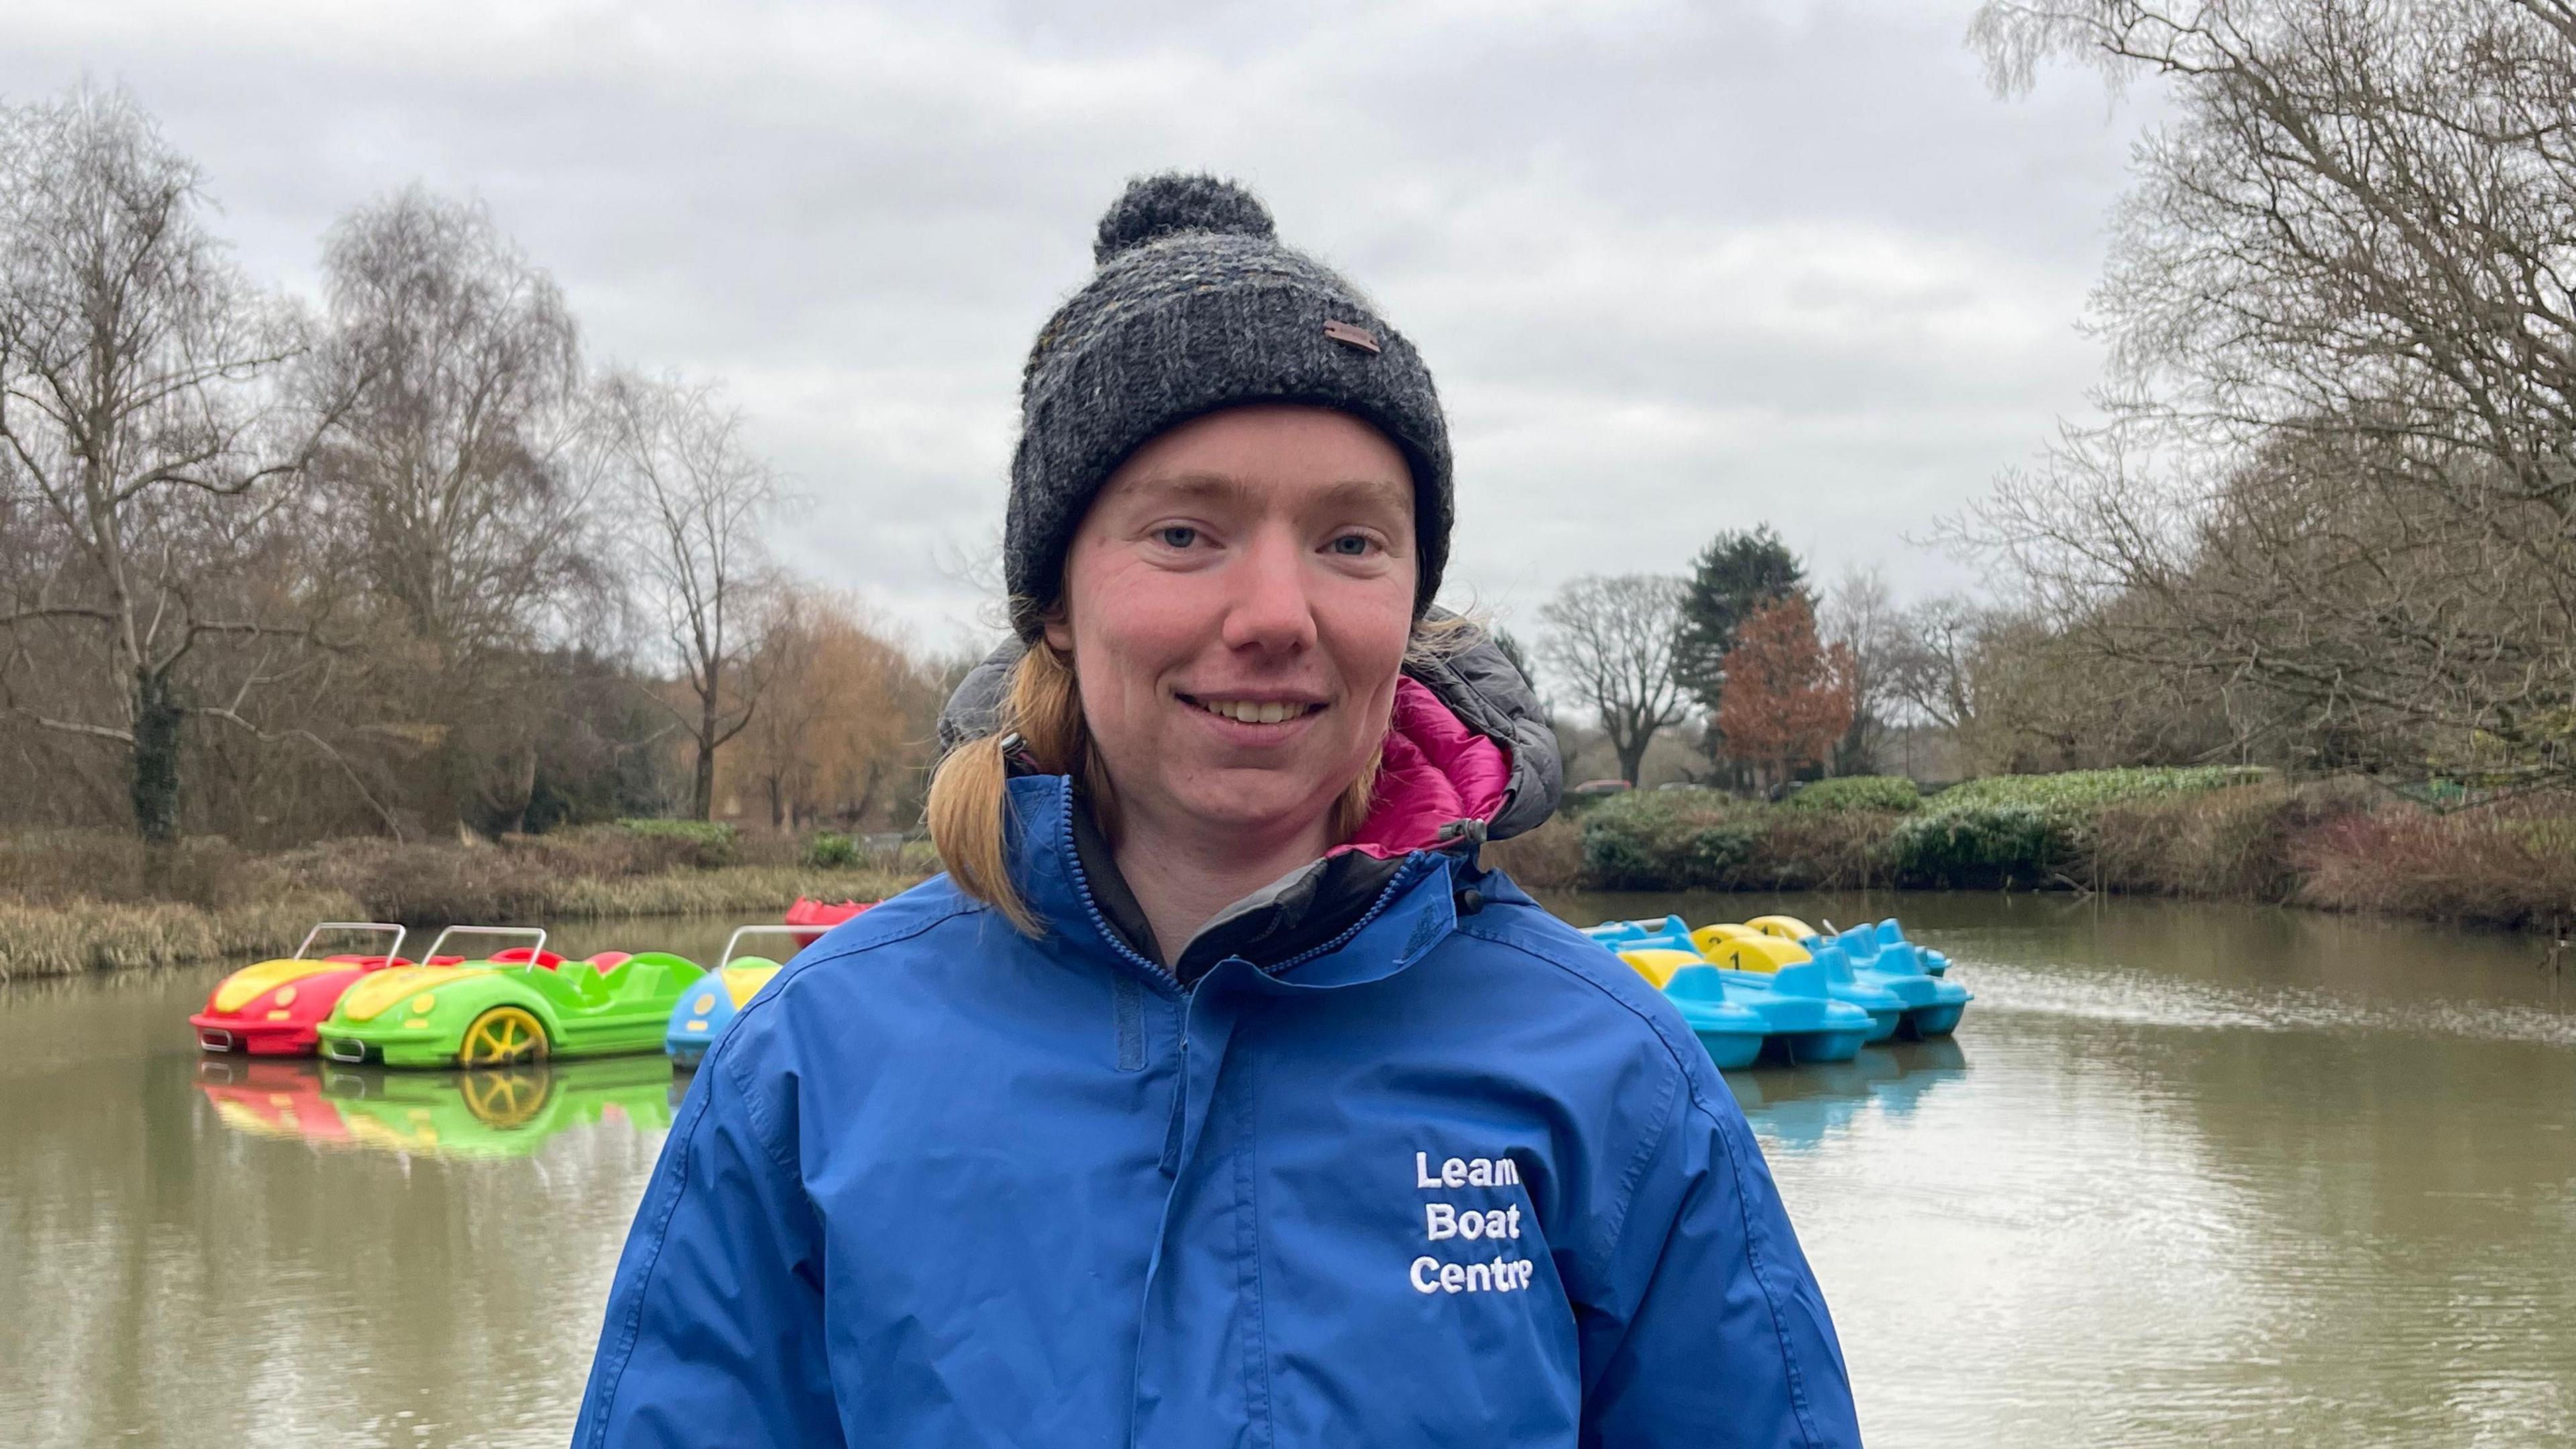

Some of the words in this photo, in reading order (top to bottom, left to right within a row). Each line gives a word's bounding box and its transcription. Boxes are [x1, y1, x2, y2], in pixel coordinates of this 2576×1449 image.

[1730, 951, 1739, 970] 1
[1416, 1151, 1519, 1188] Leam
[1426, 1203, 1520, 1240] Boat
[1410, 1255, 1533, 1293] Centre
